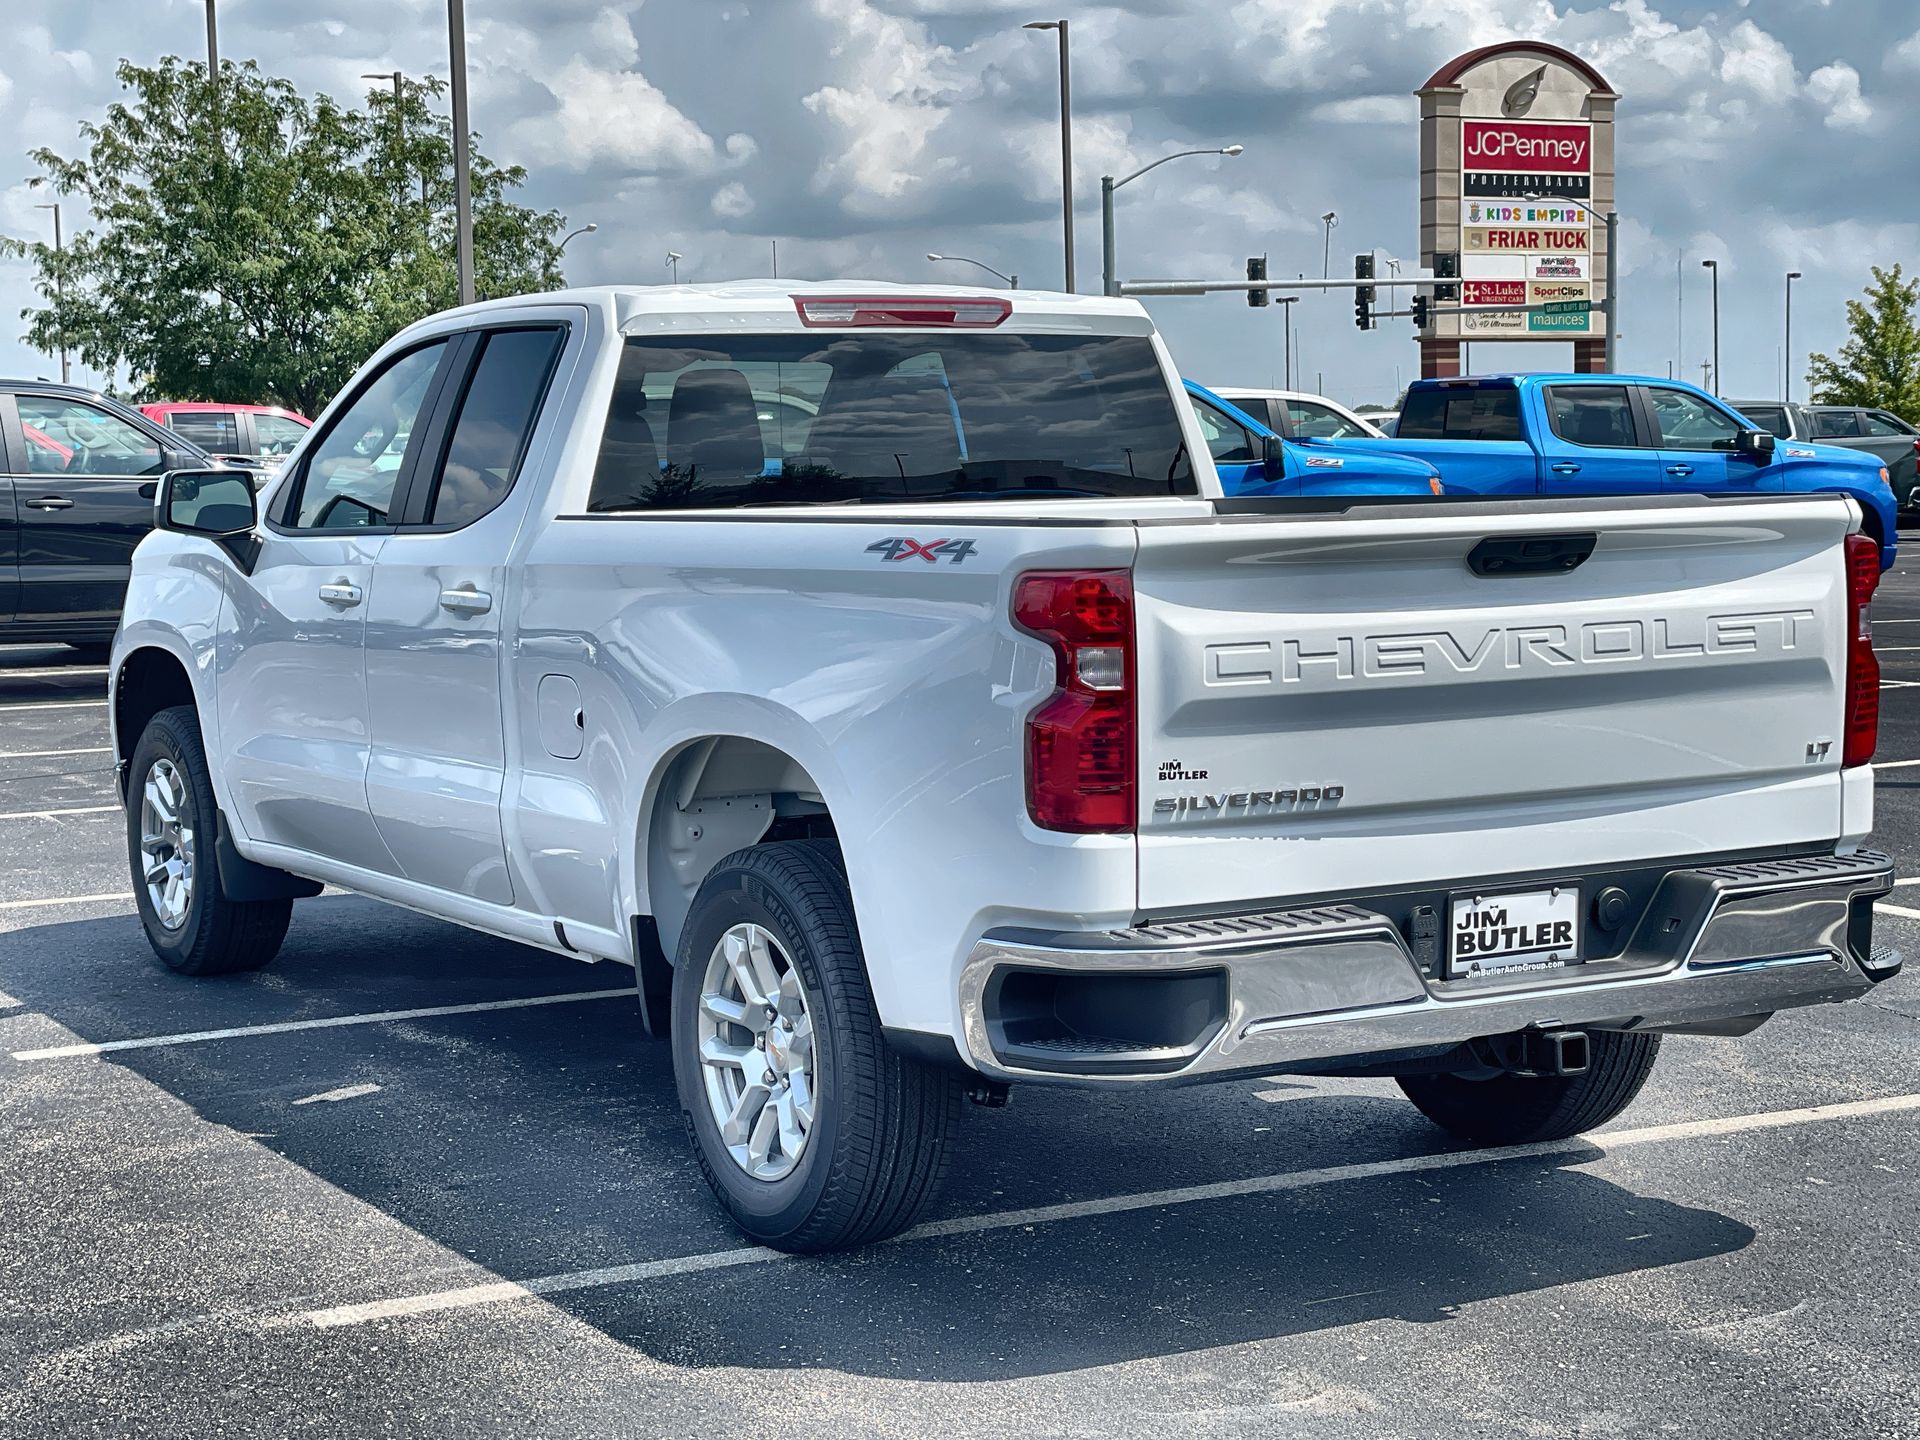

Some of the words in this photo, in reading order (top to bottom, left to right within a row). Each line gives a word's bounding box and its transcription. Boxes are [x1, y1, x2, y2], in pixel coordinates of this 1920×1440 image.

[1468, 131, 1585, 164] JCPenney
[1486, 207, 1521, 221] KIDS
[1527, 208, 1585, 222] EMPIRE
[1488, 230, 1539, 248] FRIAR
[1543, 231, 1587, 249] TUCK
[1481, 284, 1494, 295] St.
[1495, 284, 1524, 295] Luke's
[1534, 312, 1584, 325] maurices
[1203, 608, 1815, 688] CHEVROLET
[1807, 741, 1832, 757] LT
[1158, 761, 1182, 771] JIM
[1158, 770, 1208, 780] BUTLER
[1154, 786, 1344, 812] SILVERADO
[1456, 909, 1507, 930] JIM
[765, 895, 817, 989] MICHELIN
[1456, 920, 1573, 956] BUTLER
[1465, 960, 1565, 979] JimButlerAutoGroup.com
